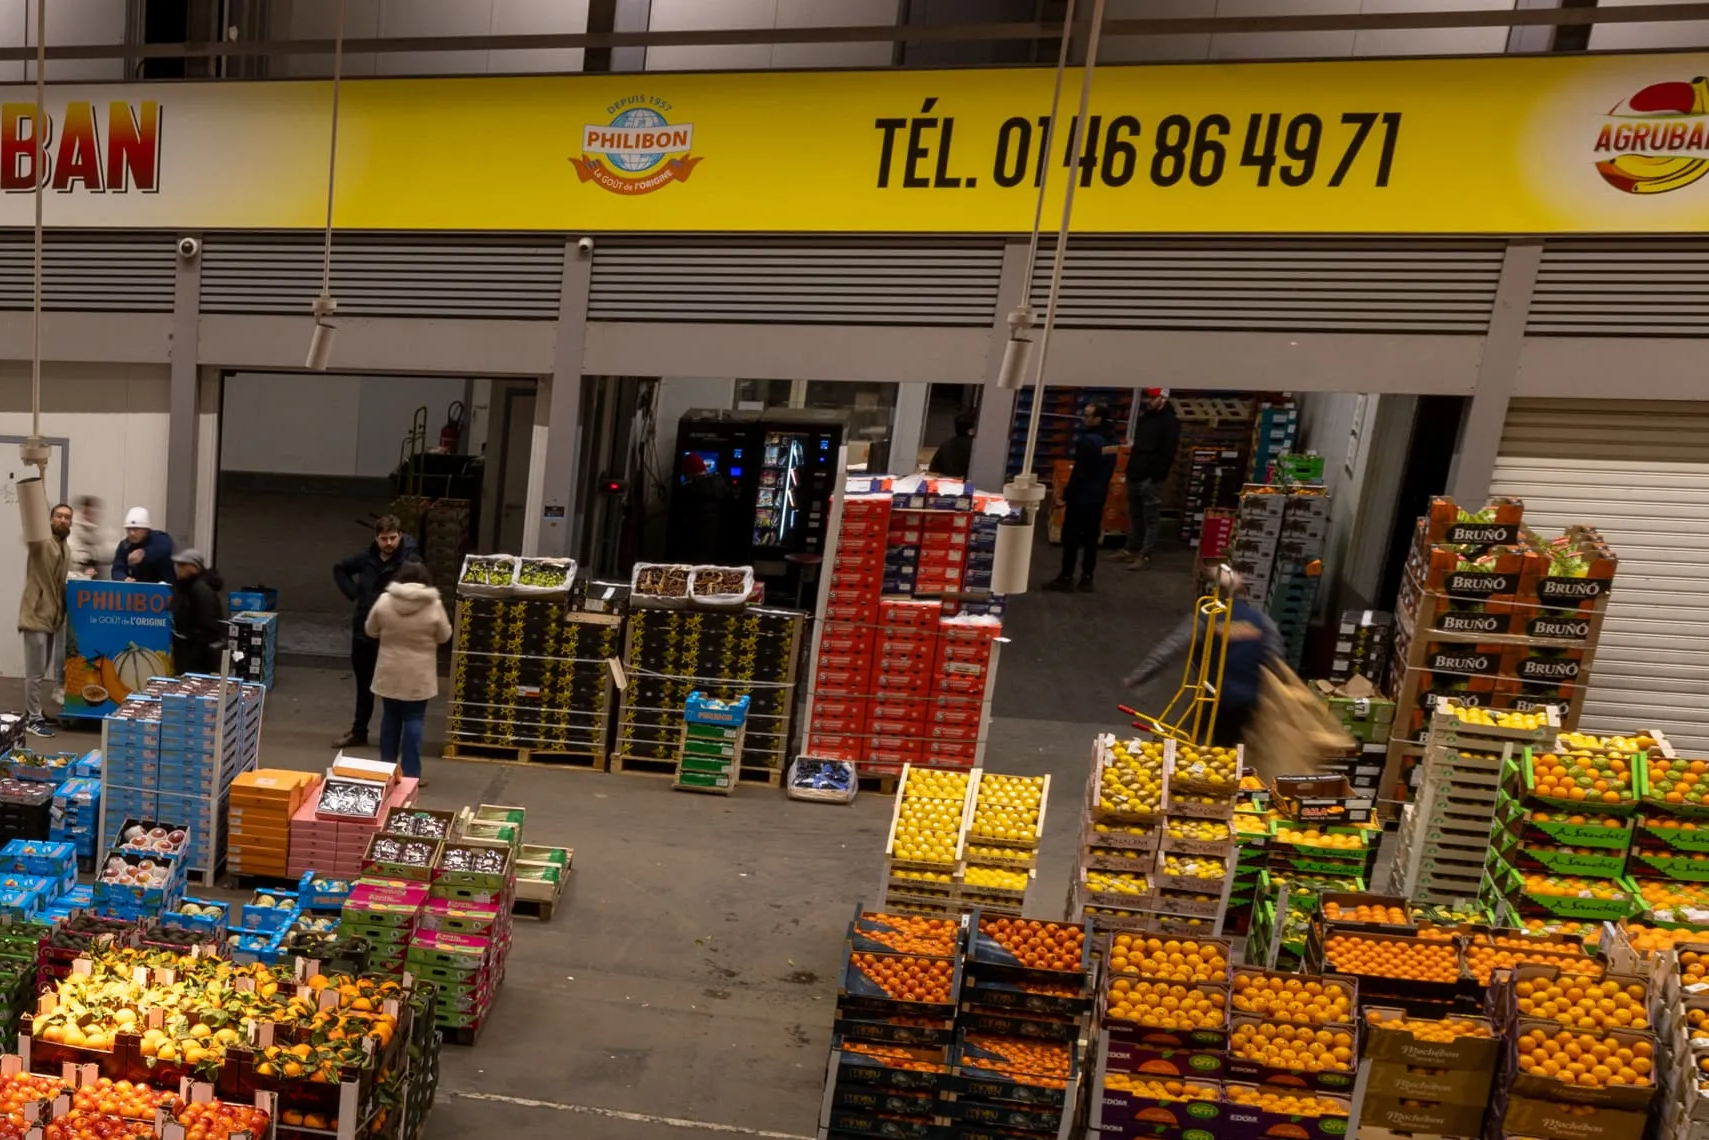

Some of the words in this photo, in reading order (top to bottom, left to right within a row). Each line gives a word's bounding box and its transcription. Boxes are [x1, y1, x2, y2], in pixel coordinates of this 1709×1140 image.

[607, 94, 645, 114] DEPUIS
[649, 95, 673, 112] 1957
[587, 130, 688, 149] PHILIBON
[875, 97, 977, 188] TÉL.
[993, 116, 1052, 188] 01
[1063, 115, 1141, 188] 46
[1149, 114, 1230, 188] 86
[1239, 112, 1322, 187] 49
[1327, 111, 1402, 187] 71
[1594, 121, 1709, 152] AGRUBA
[601, 175, 623, 191] GOÛT
[624, 183, 632, 191] de
